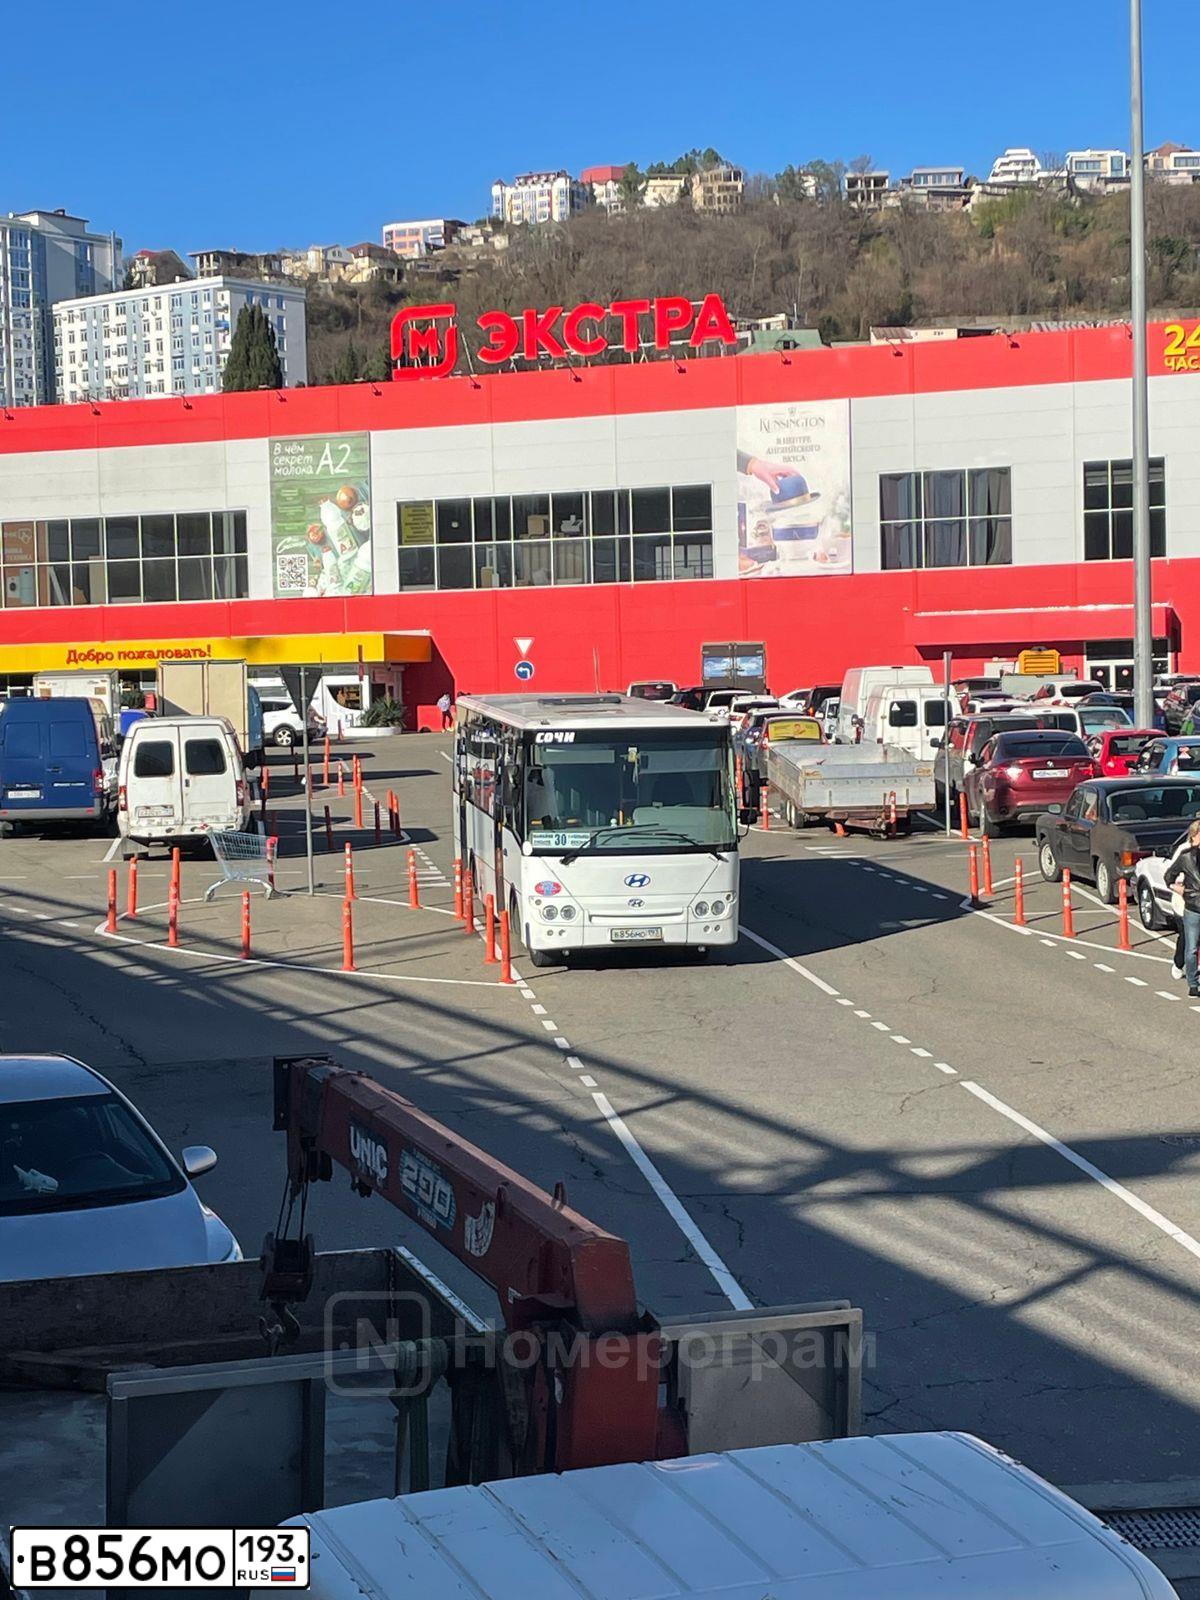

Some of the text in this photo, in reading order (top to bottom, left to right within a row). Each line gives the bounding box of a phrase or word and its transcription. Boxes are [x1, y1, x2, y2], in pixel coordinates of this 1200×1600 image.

[476, 293, 737, 363] ЭКСТРА
[1164, 324, 1200, 356] 24
[273, 442, 282, 455] В
[273, 454, 313, 467] секрет
[316, 442, 351, 475] А2
[274, 465, 314, 476] молока
[66, 644, 212, 665] Добро пожаловать!
[535, 731, 576, 744] СОЧИ
[554, 833, 567, 846] 30
[350, 1125, 388, 1180] UNIC
